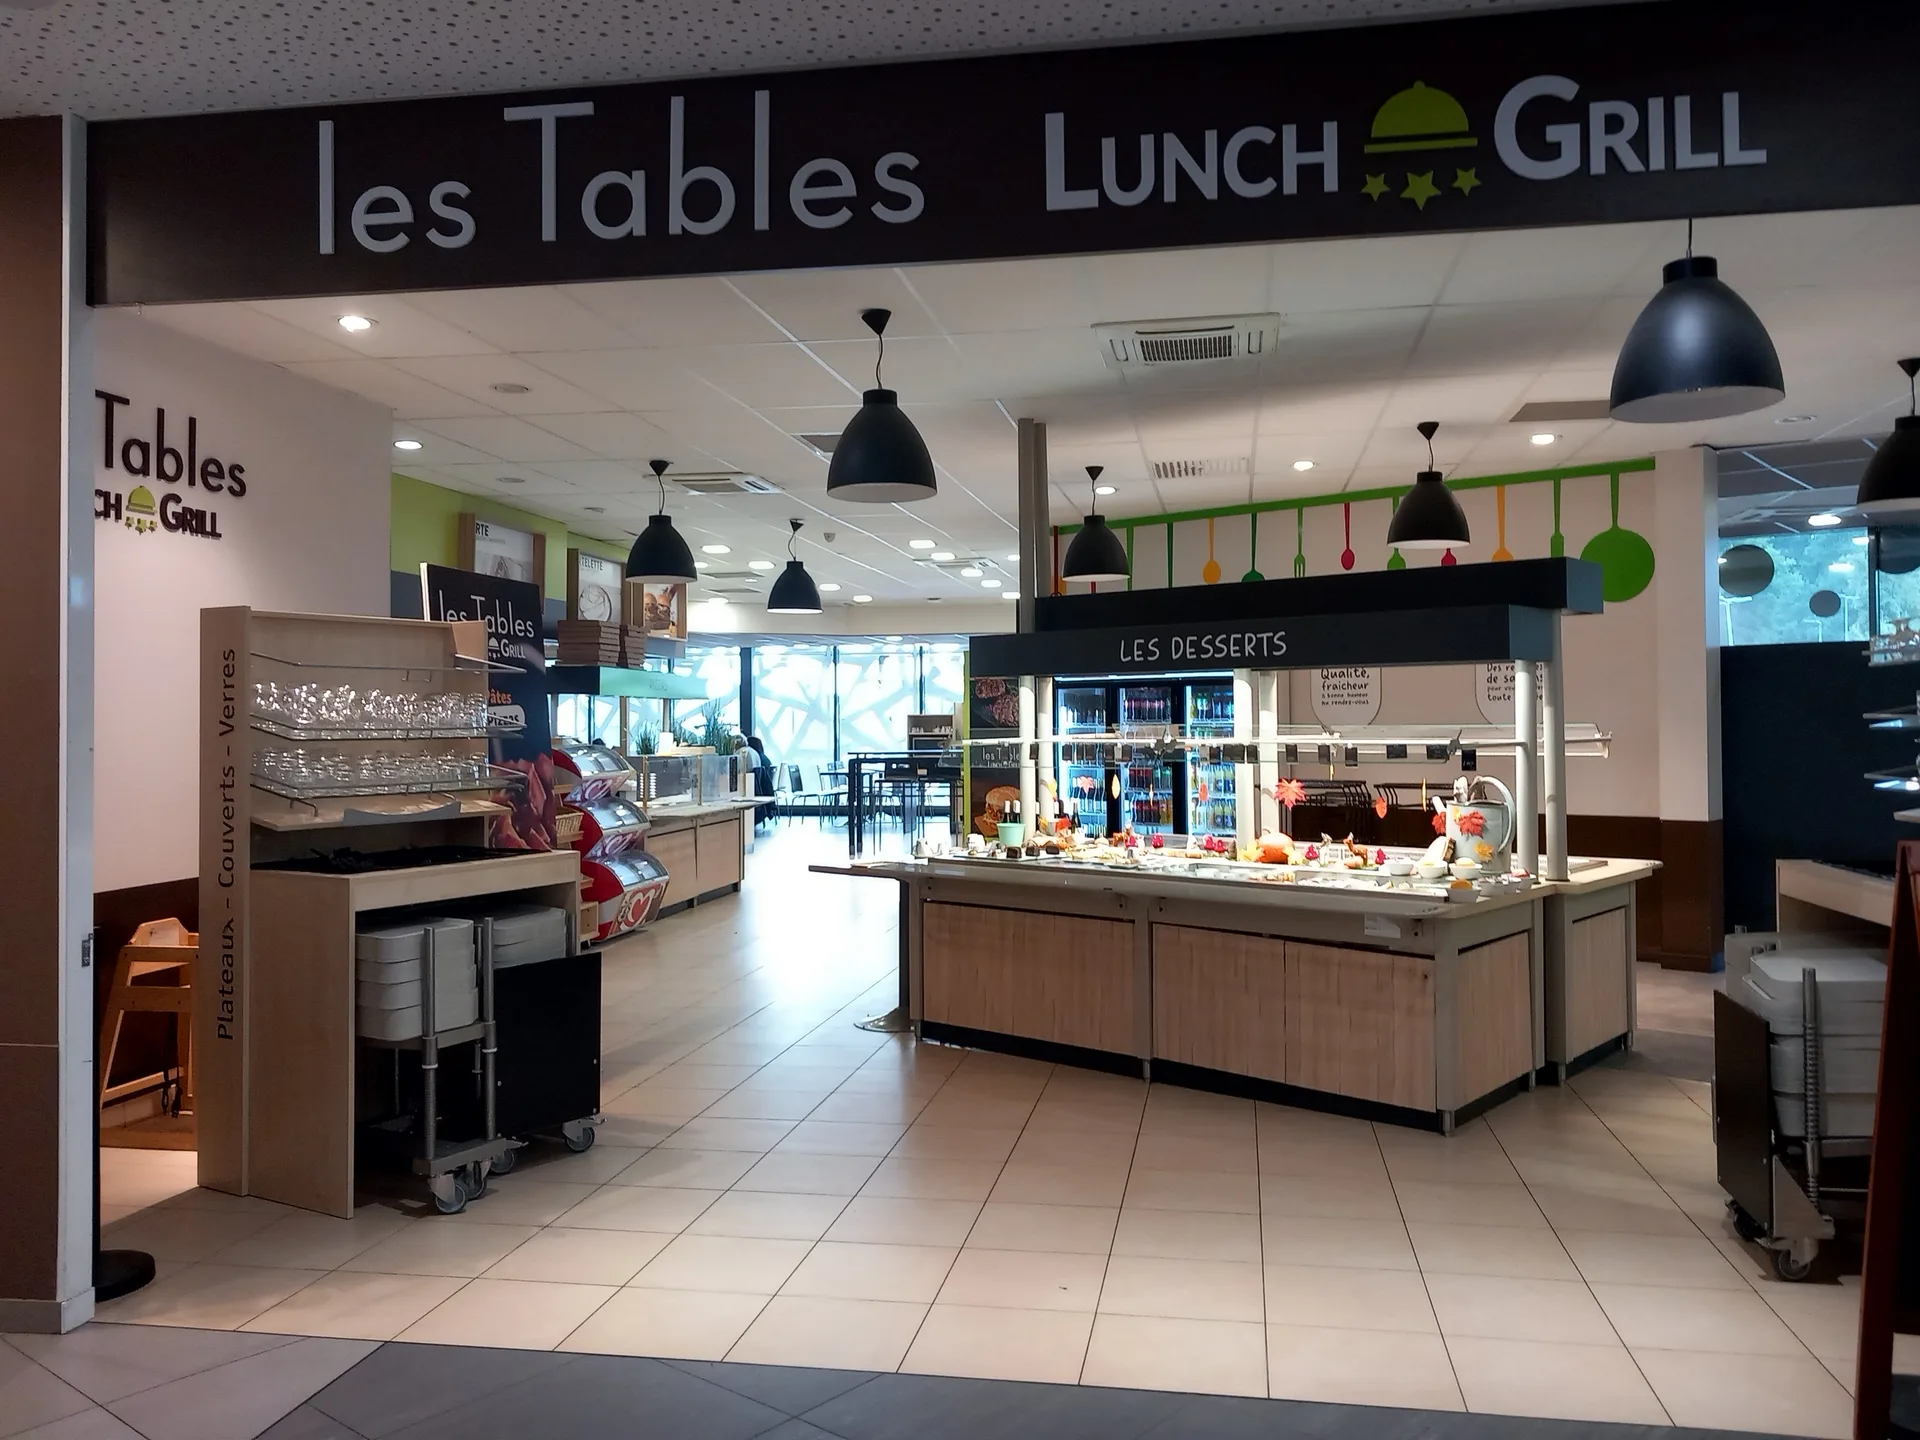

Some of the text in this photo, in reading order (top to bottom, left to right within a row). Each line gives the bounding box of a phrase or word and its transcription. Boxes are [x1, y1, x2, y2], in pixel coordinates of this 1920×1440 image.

[319, 89, 925, 255] les Tables
[1045, 74, 1767, 211] LUNCH GRILL
[94, 389, 247, 498] Tables
[159, 492, 222, 538] GRILL
[470, 595, 535, 638] Tables
[500, 639, 526, 659] GRILL
[1119, 630, 1287, 663] LES DESSERTS
[218, 648, 236, 738] Verres
[1486, 673, 1499, 684] de
[217, 765, 236, 888] Couverts
[216, 917, 235, 1041] Plateaux
